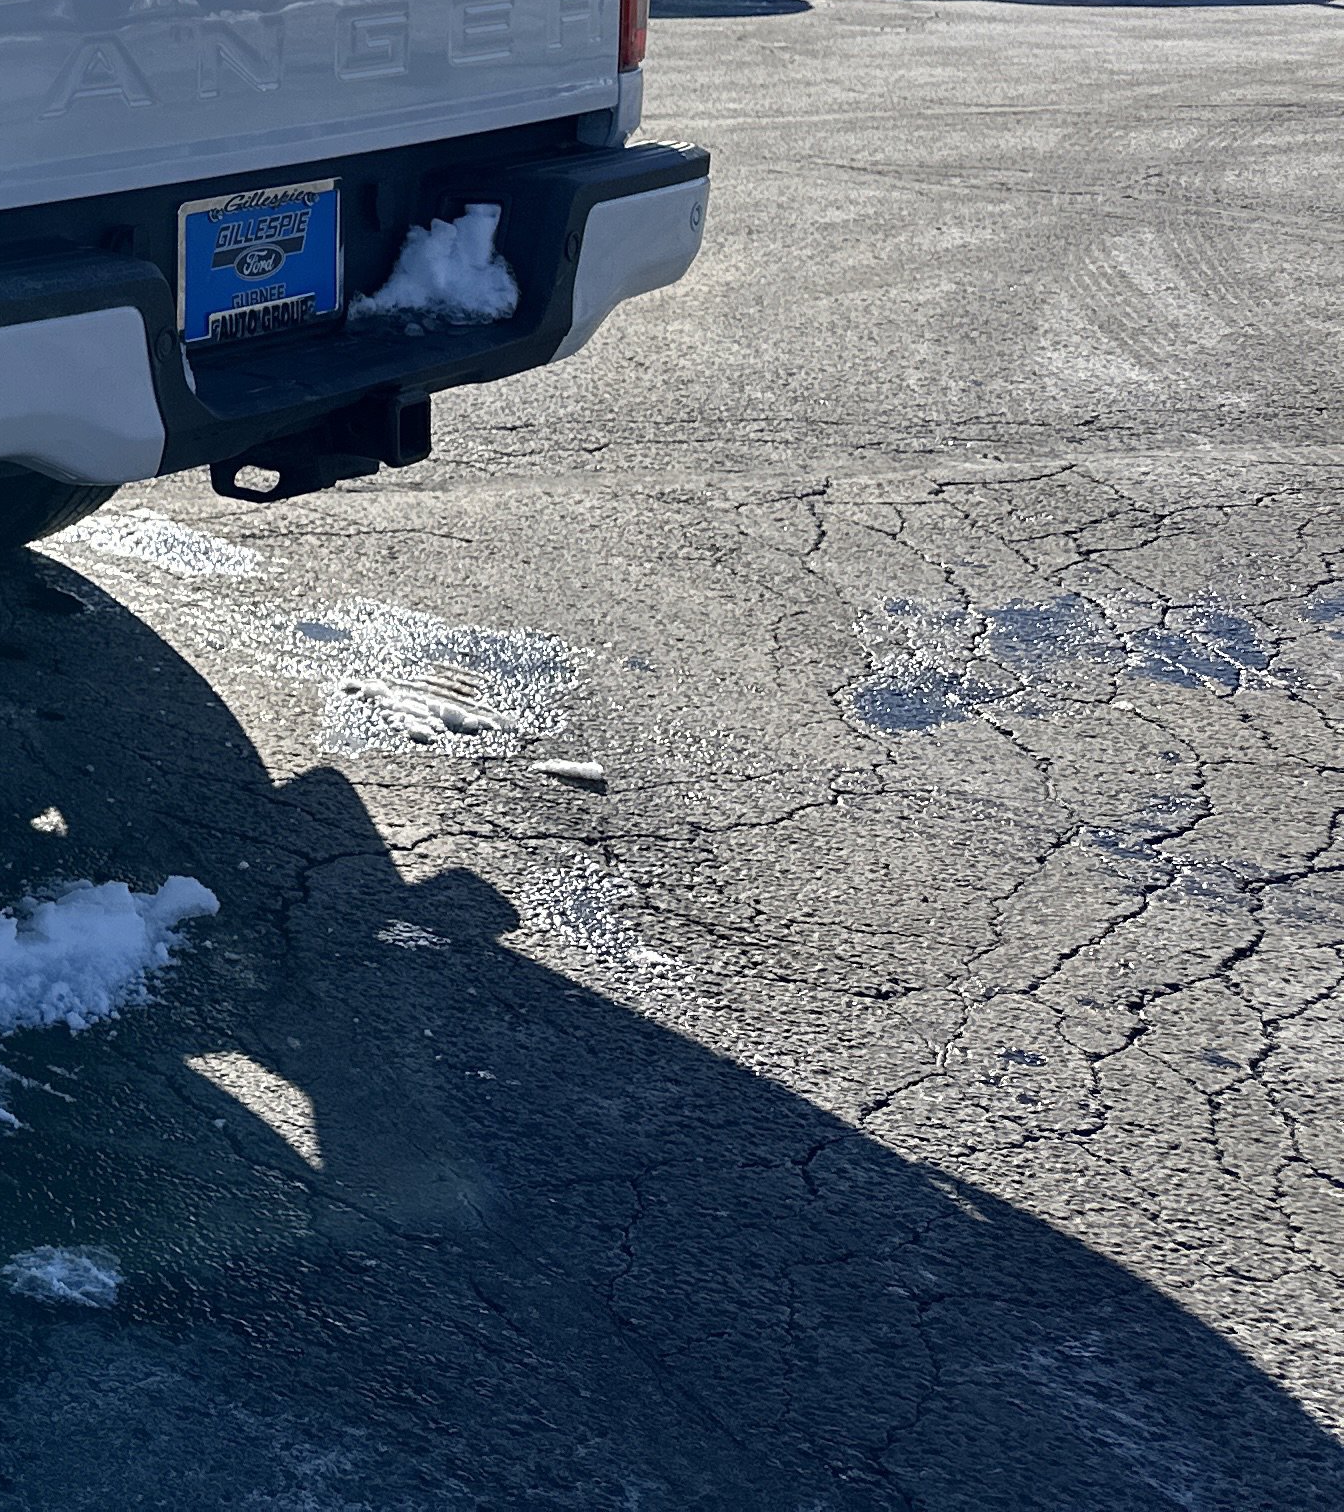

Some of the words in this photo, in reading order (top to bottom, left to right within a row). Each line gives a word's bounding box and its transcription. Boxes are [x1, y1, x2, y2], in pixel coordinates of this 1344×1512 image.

[224, 188, 305, 213] Gillespie
[215, 210, 310, 249] GILLESPIE
[243, 250, 275, 276] Ford
[219, 309, 258, 337] AUTO
[261, 297, 309, 330] GROUP
